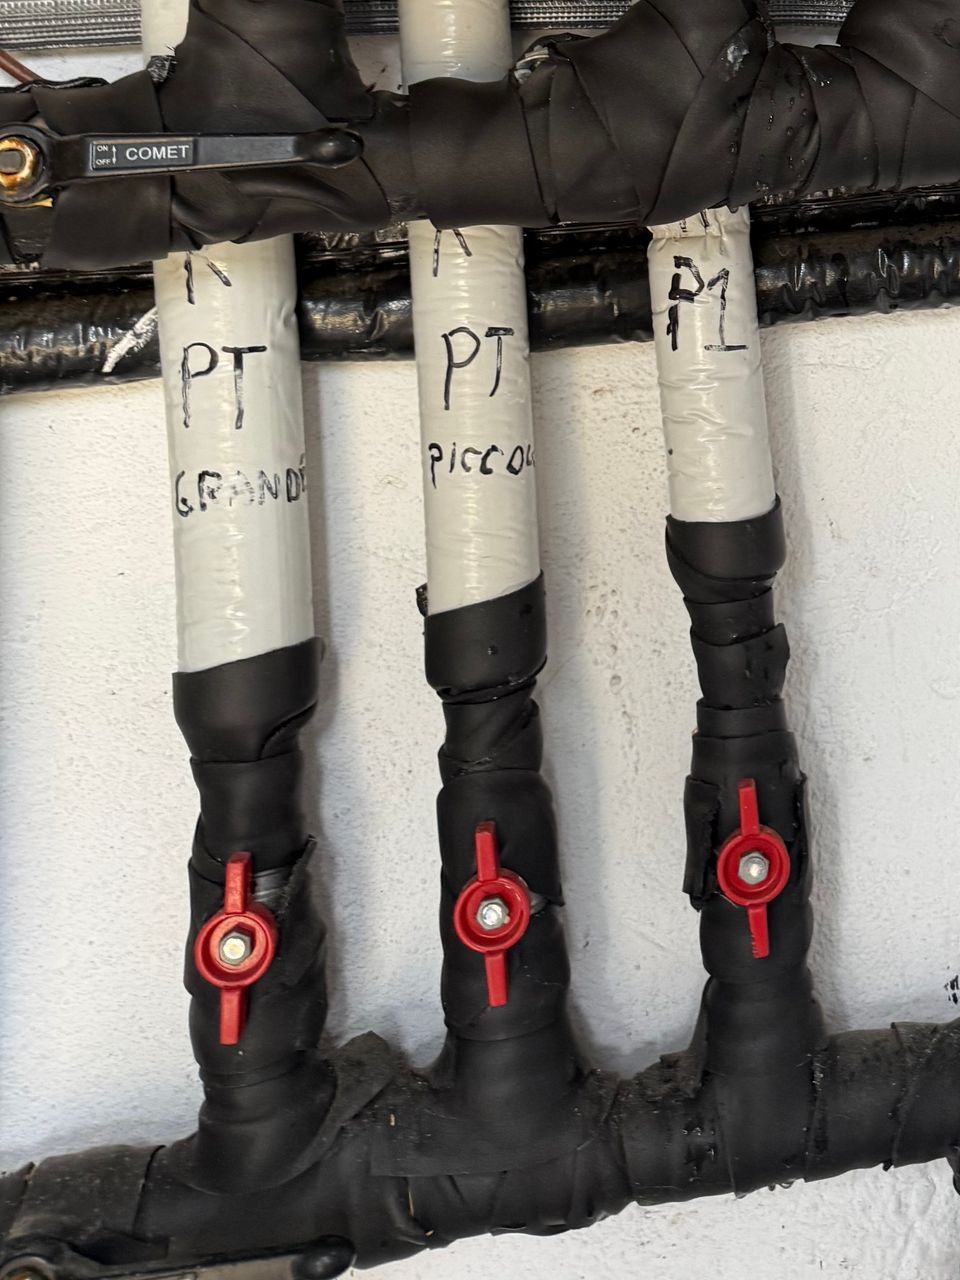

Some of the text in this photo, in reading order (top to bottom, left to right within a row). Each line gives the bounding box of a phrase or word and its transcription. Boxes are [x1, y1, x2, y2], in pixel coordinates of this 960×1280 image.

[95, 158, 111, 166] OFF
[125, 145, 190, 161] COMET
[666, 255, 748, 352] P1
[181, 342, 268, 430] PT
[441, 326, 515, 411] PT
